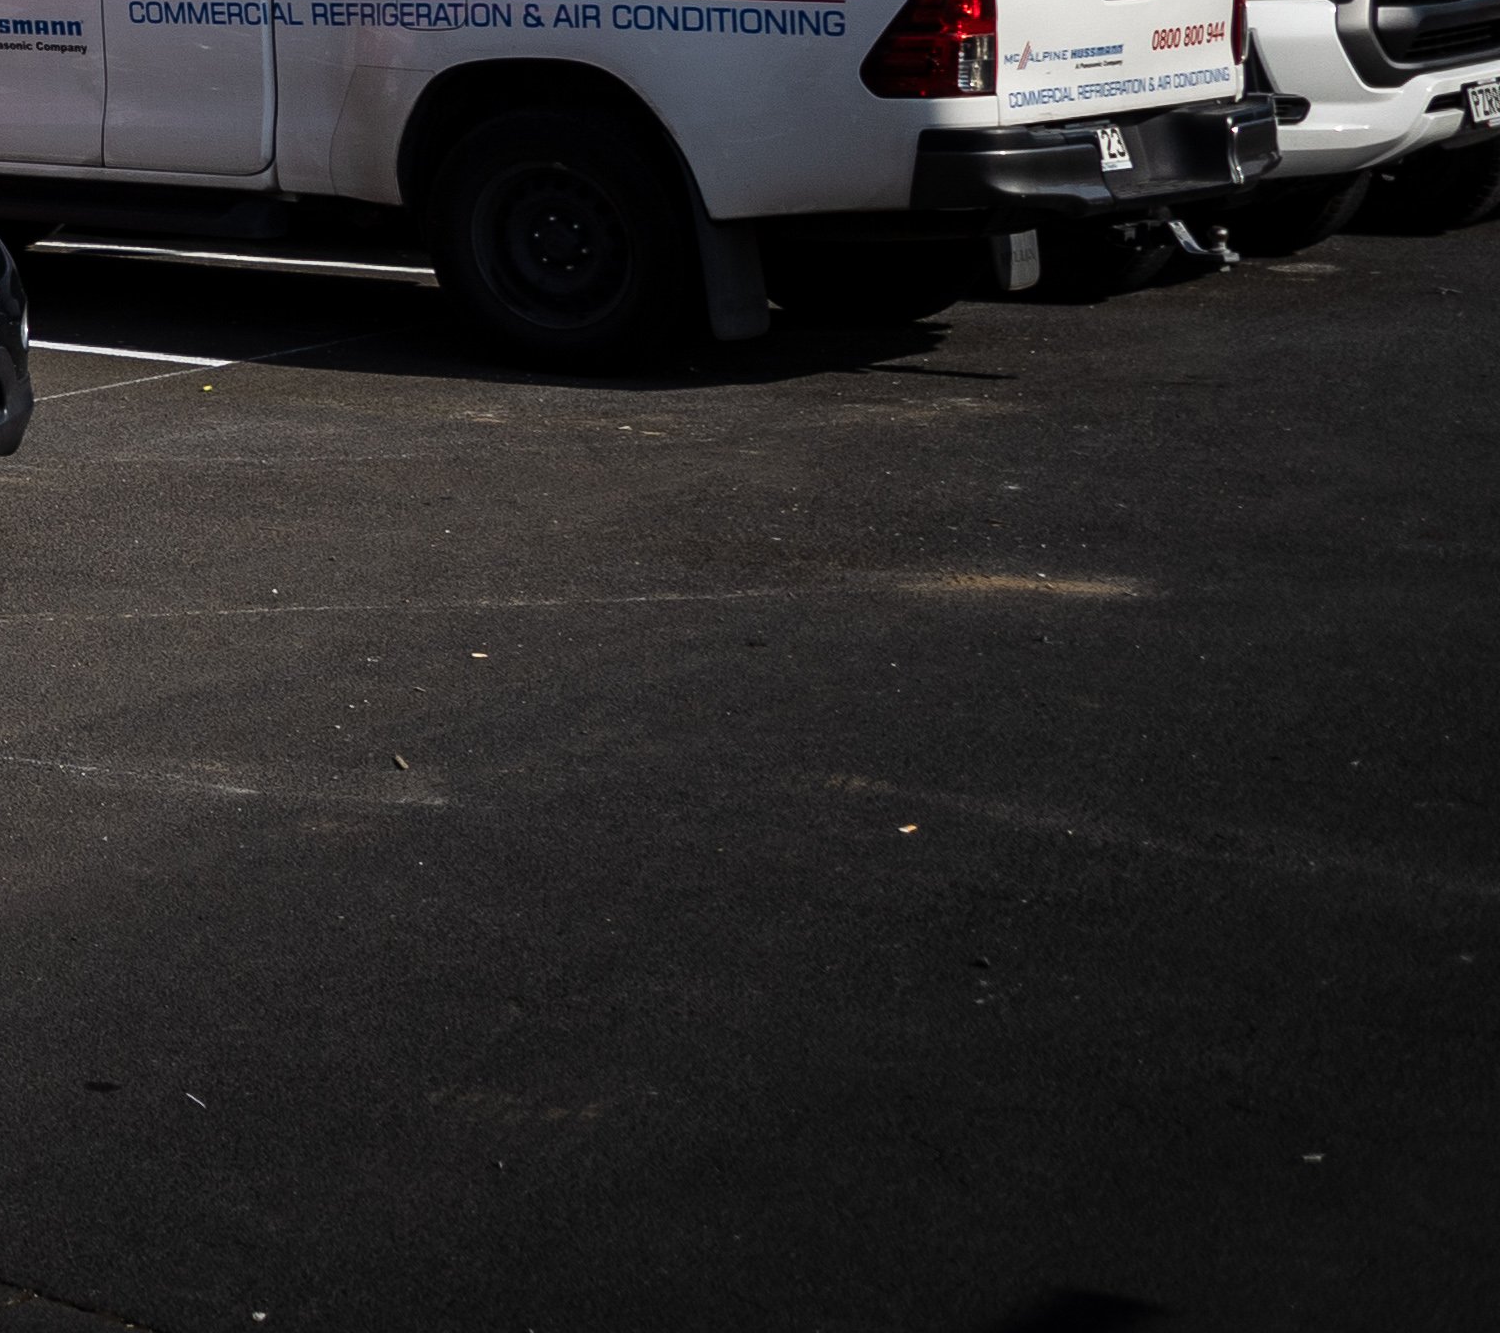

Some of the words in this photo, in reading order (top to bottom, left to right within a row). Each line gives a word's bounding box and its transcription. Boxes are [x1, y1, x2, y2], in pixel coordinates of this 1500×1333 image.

[128, 0, 303, 27] COMMERCIAL
[310, 1, 514, 29] REFRIGERATION
[522, 4, 545, 29] &
[554, 4, 601, 30] AIR
[611, 4, 846, 38] CONDITIONING
[1151, 28, 1181, 51] 0800
[1183, 24, 1205, 46] 800
[1207, 21, 1225, 44] 944
[36, 41, 88, 55] Company
[1008, 89, 1075, 108] COMMERCIAL
[1077, 78, 1146, 101] REFRIGERATION
[1148, 76, 1155, 92] &
[1157, 74, 1171, 90] AIR
[1173, 66, 1231, 89] CONDITIONING
